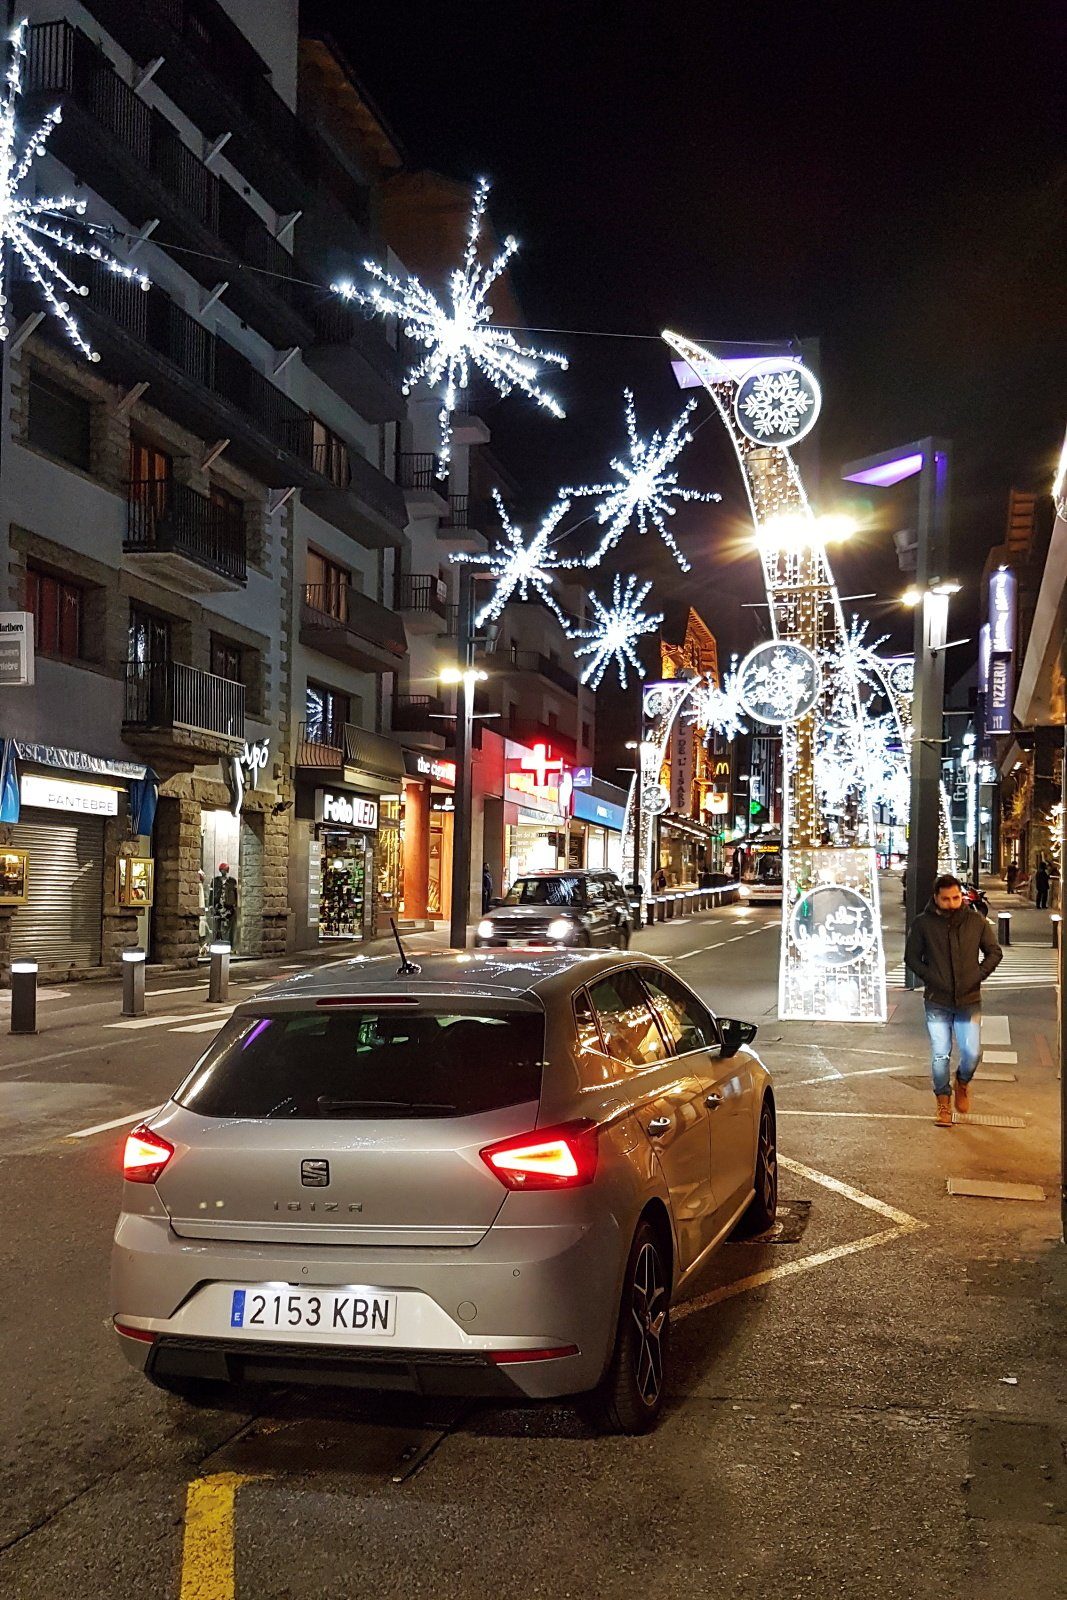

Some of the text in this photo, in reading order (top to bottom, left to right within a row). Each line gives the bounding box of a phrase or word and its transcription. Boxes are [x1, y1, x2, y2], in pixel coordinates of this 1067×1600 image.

[993, 659, 1006, 708] PIZZERIA
[417, 756, 431, 774] the
[48, 793, 114, 813] PANTEBRE
[357, 801, 375, 825] LED
[273, 1201, 363, 1213] IBIZA
[234, 1312, 241, 1321] E
[250, 1295, 389, 1330] 2153 KBN
